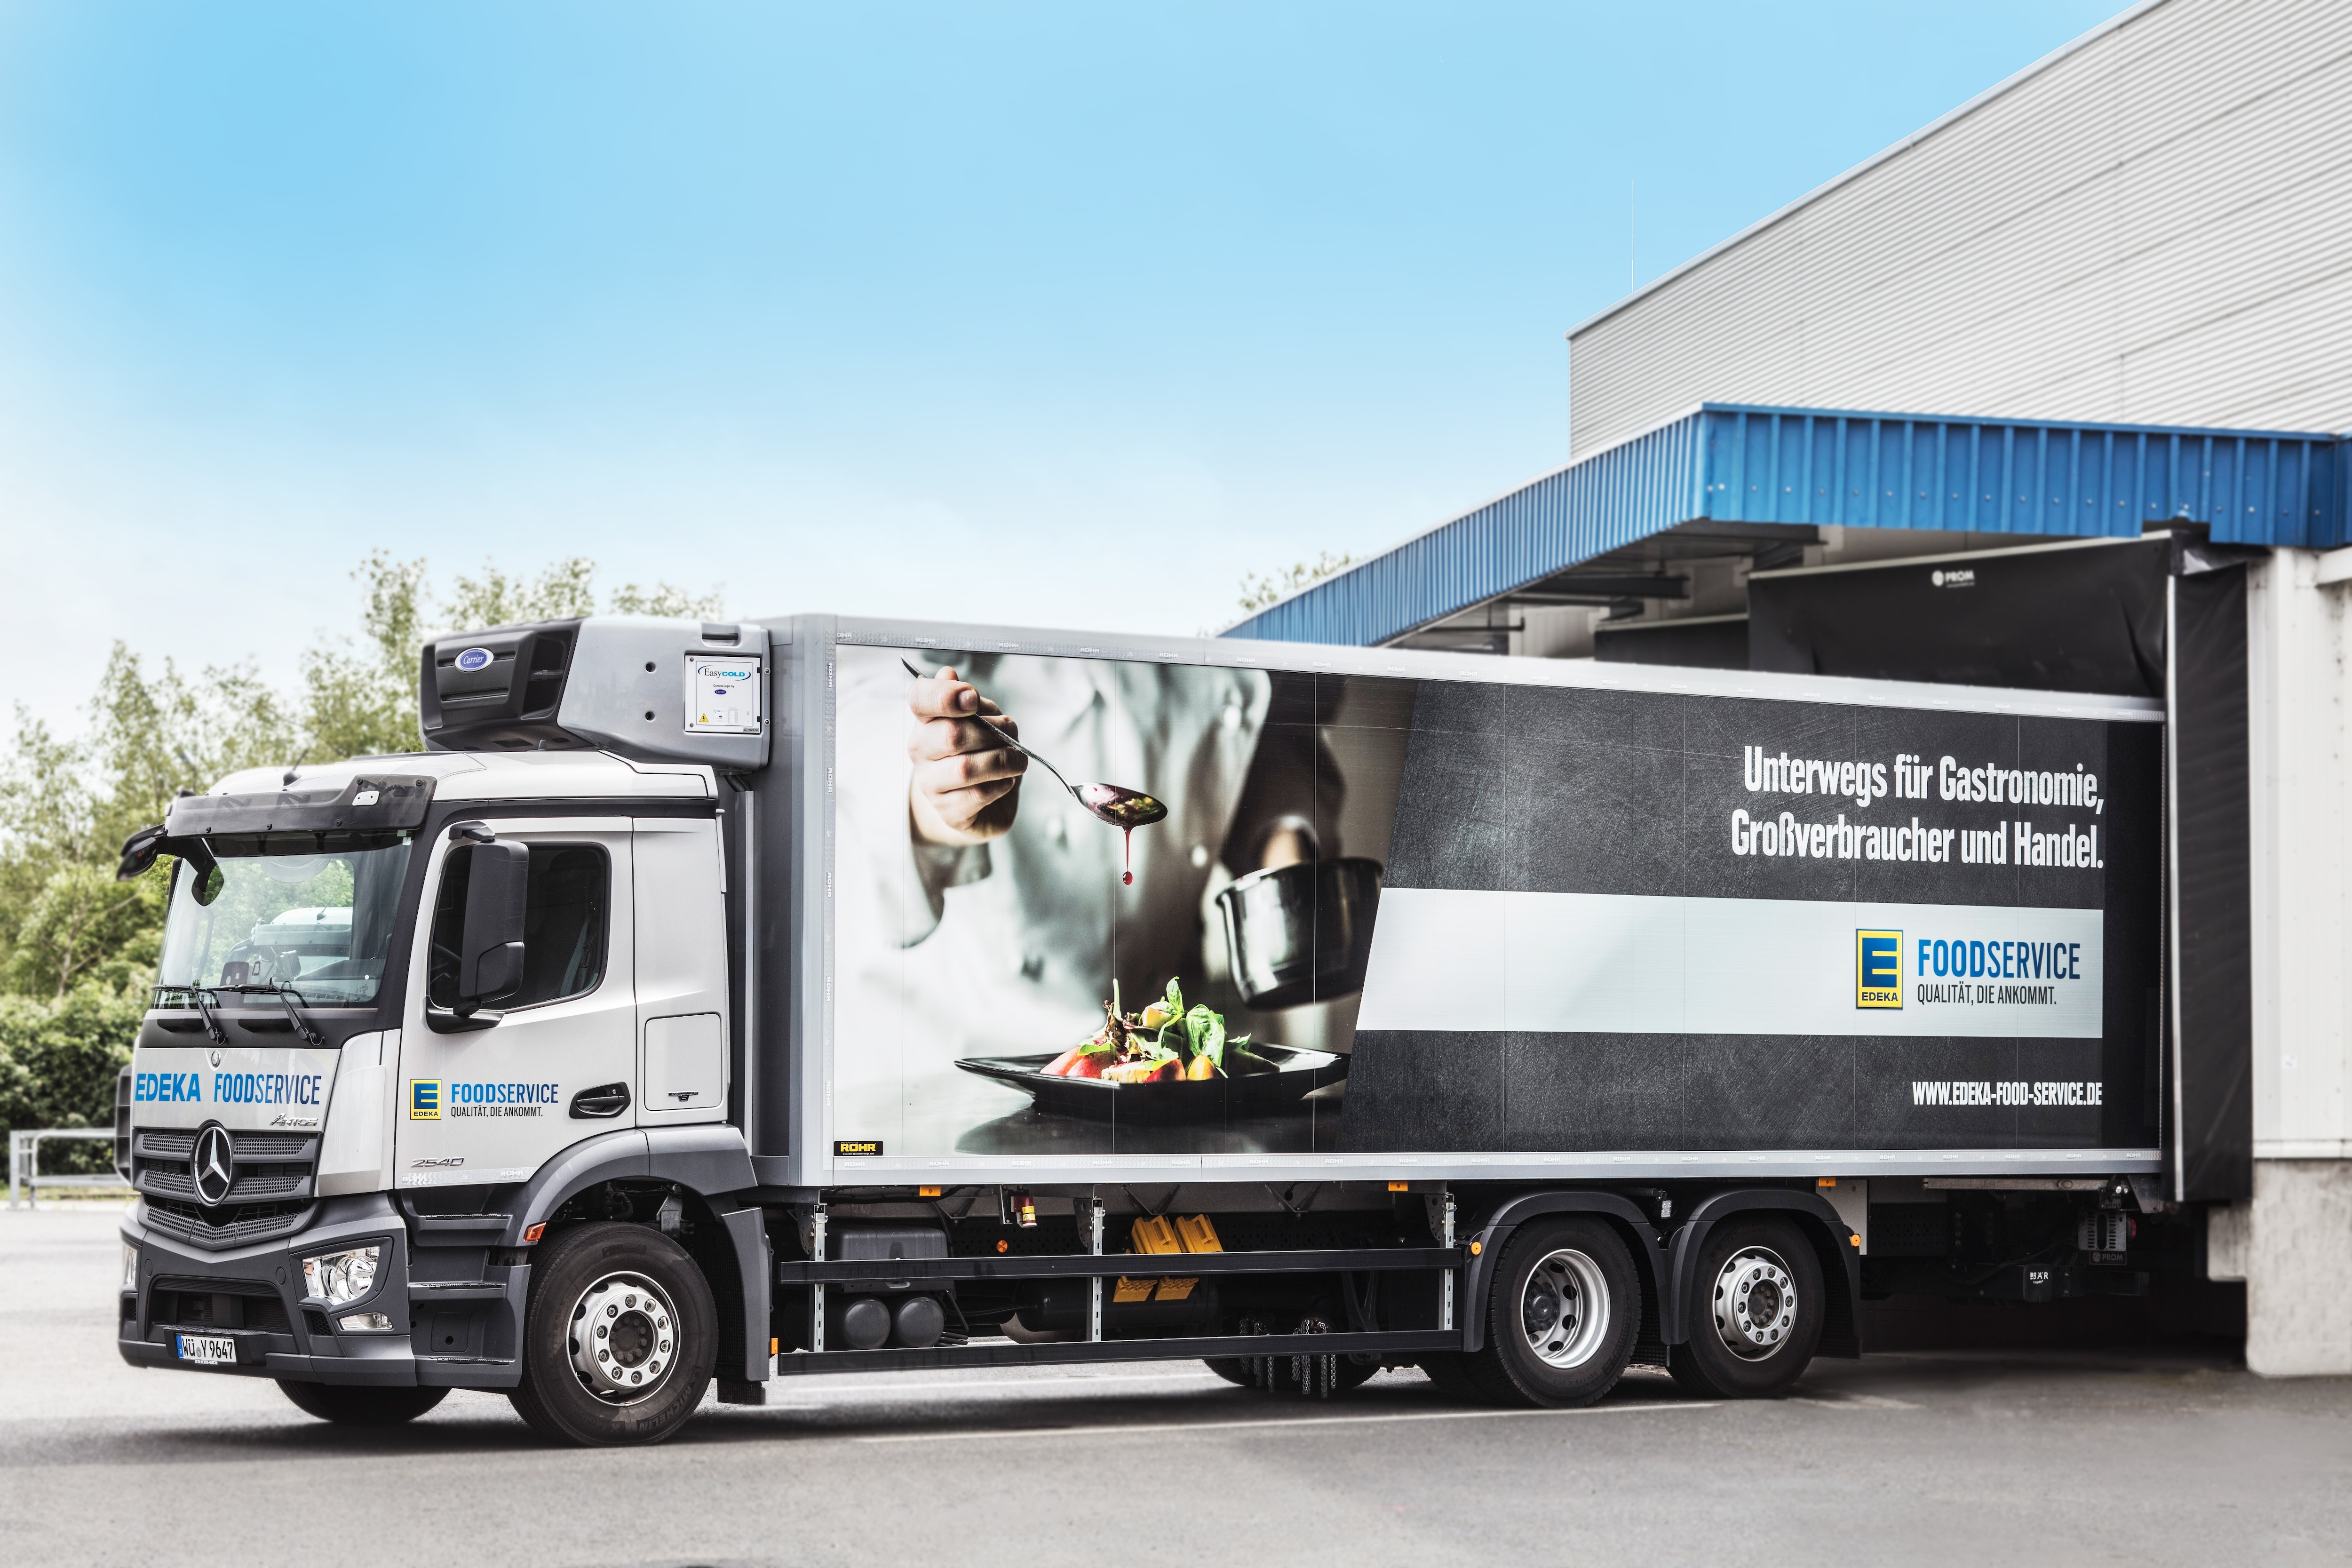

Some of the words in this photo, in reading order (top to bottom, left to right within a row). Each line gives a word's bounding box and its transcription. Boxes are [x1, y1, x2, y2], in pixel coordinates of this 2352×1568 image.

[1945, 571, 1974, 582] PROM
[463, 655, 484, 664] Carrier
[705, 669, 745, 677] EasyCOLD
[1744, 745, 1887, 807] Unterwegs
[1894, 754, 1933, 799] für
[1939, 755, 2104, 815] Gastronomie,
[1732, 809, 1955, 863] Großverbraucher
[1961, 820, 2007, 865] und
[2014, 822, 2103, 868] Handel.
[1917, 939, 2081, 980] FOODSERVICE
[1861, 992, 1898, 1002] EDEKA
[1917, 981, 1974, 1006] QUALITÄT,
[1977, 986, 1994, 1004] DIE
[1997, 986, 2057, 1005] ANKOMMT.
[135, 1073, 201, 1102] EDEKA
[214, 1074, 322, 1105] FOODSERVICE
[452, 1083, 558, 1103] FOODSERVICE
[1913, 1081, 2102, 1106] WWW.EDEKA-FOOD-SERVICE.DE
[451, 1105, 488, 1118] QUALITÄT,
[490, 1106, 502, 1116] DIE
[504, 1107, 542, 1117] ANKOMMT.
[411, 1156, 464, 1168] 2540
[182, 1338, 195, 1357] WÜ
[200, 1340, 207, 1357] Y
[209, 1340, 233, 1359] 9647
[636, 1383, 693, 1433] MICHELIN
